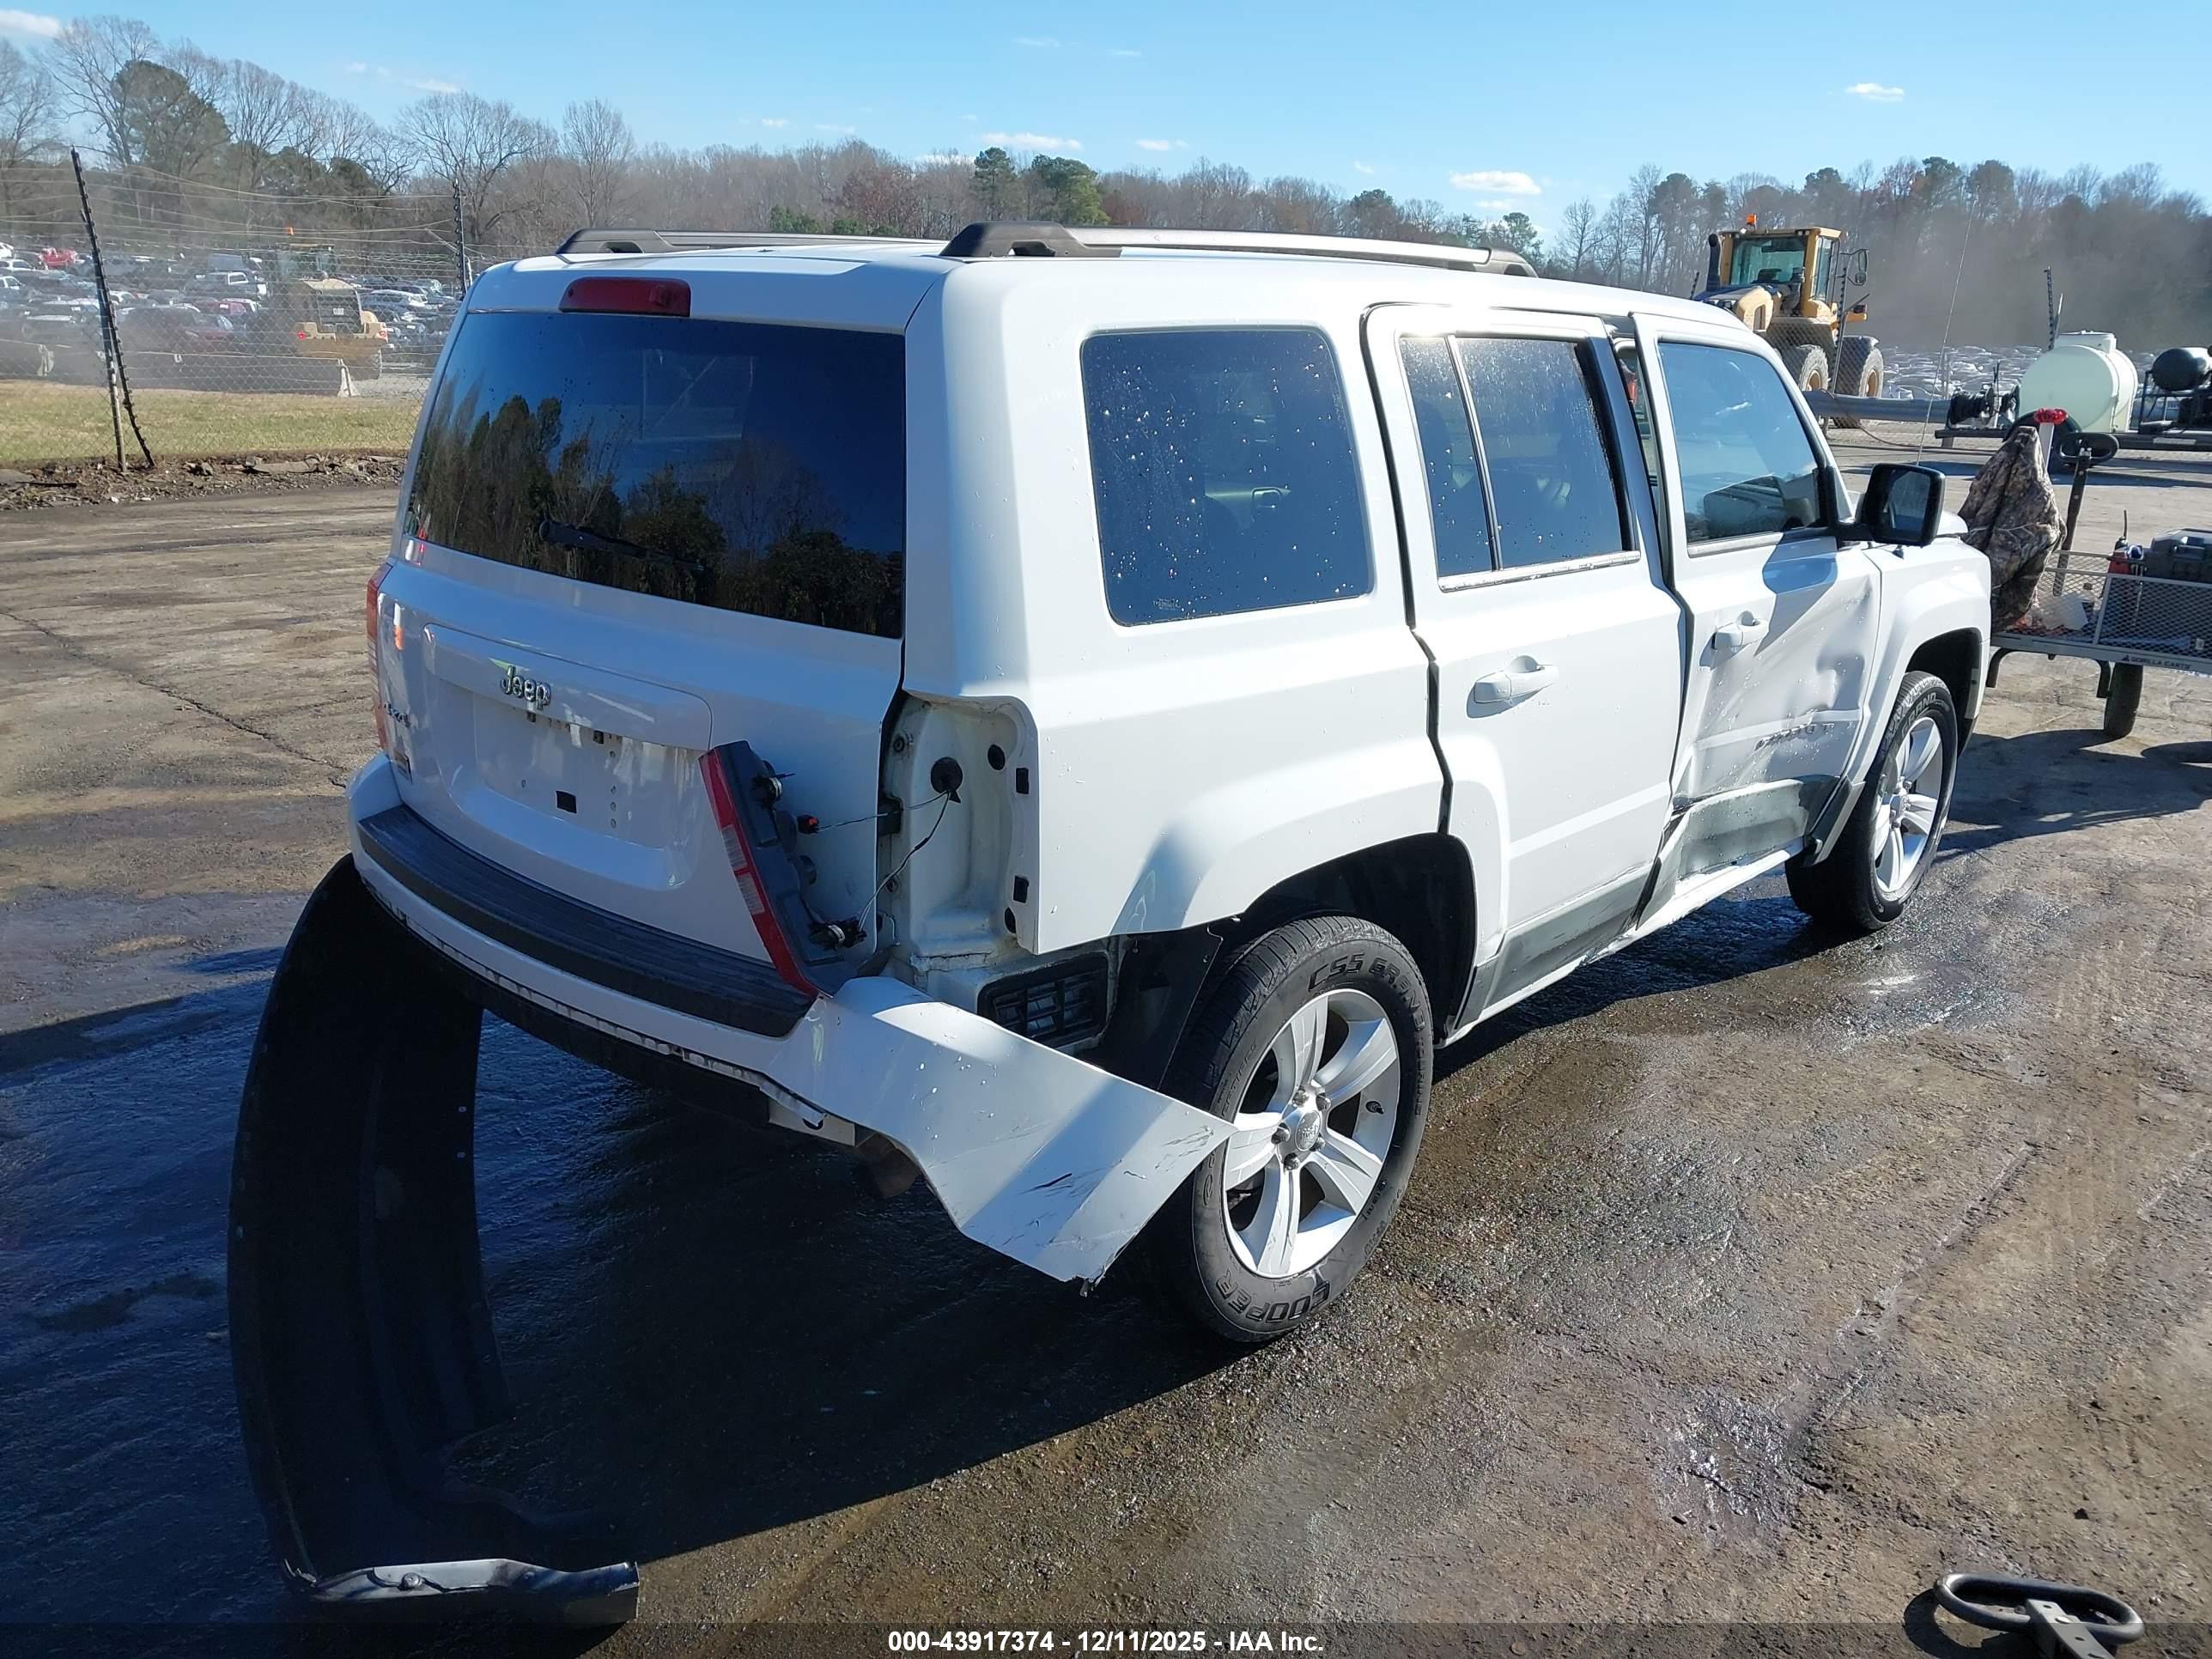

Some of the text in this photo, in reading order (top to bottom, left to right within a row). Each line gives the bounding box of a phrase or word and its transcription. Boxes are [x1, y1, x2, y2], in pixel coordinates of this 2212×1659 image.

[501, 665, 550, 710] Jeep
[1309, 953, 1365, 993] CS5
[1368, 957, 1425, 1030] GRAND
[1216, 1268, 1330, 1322] COOPER
